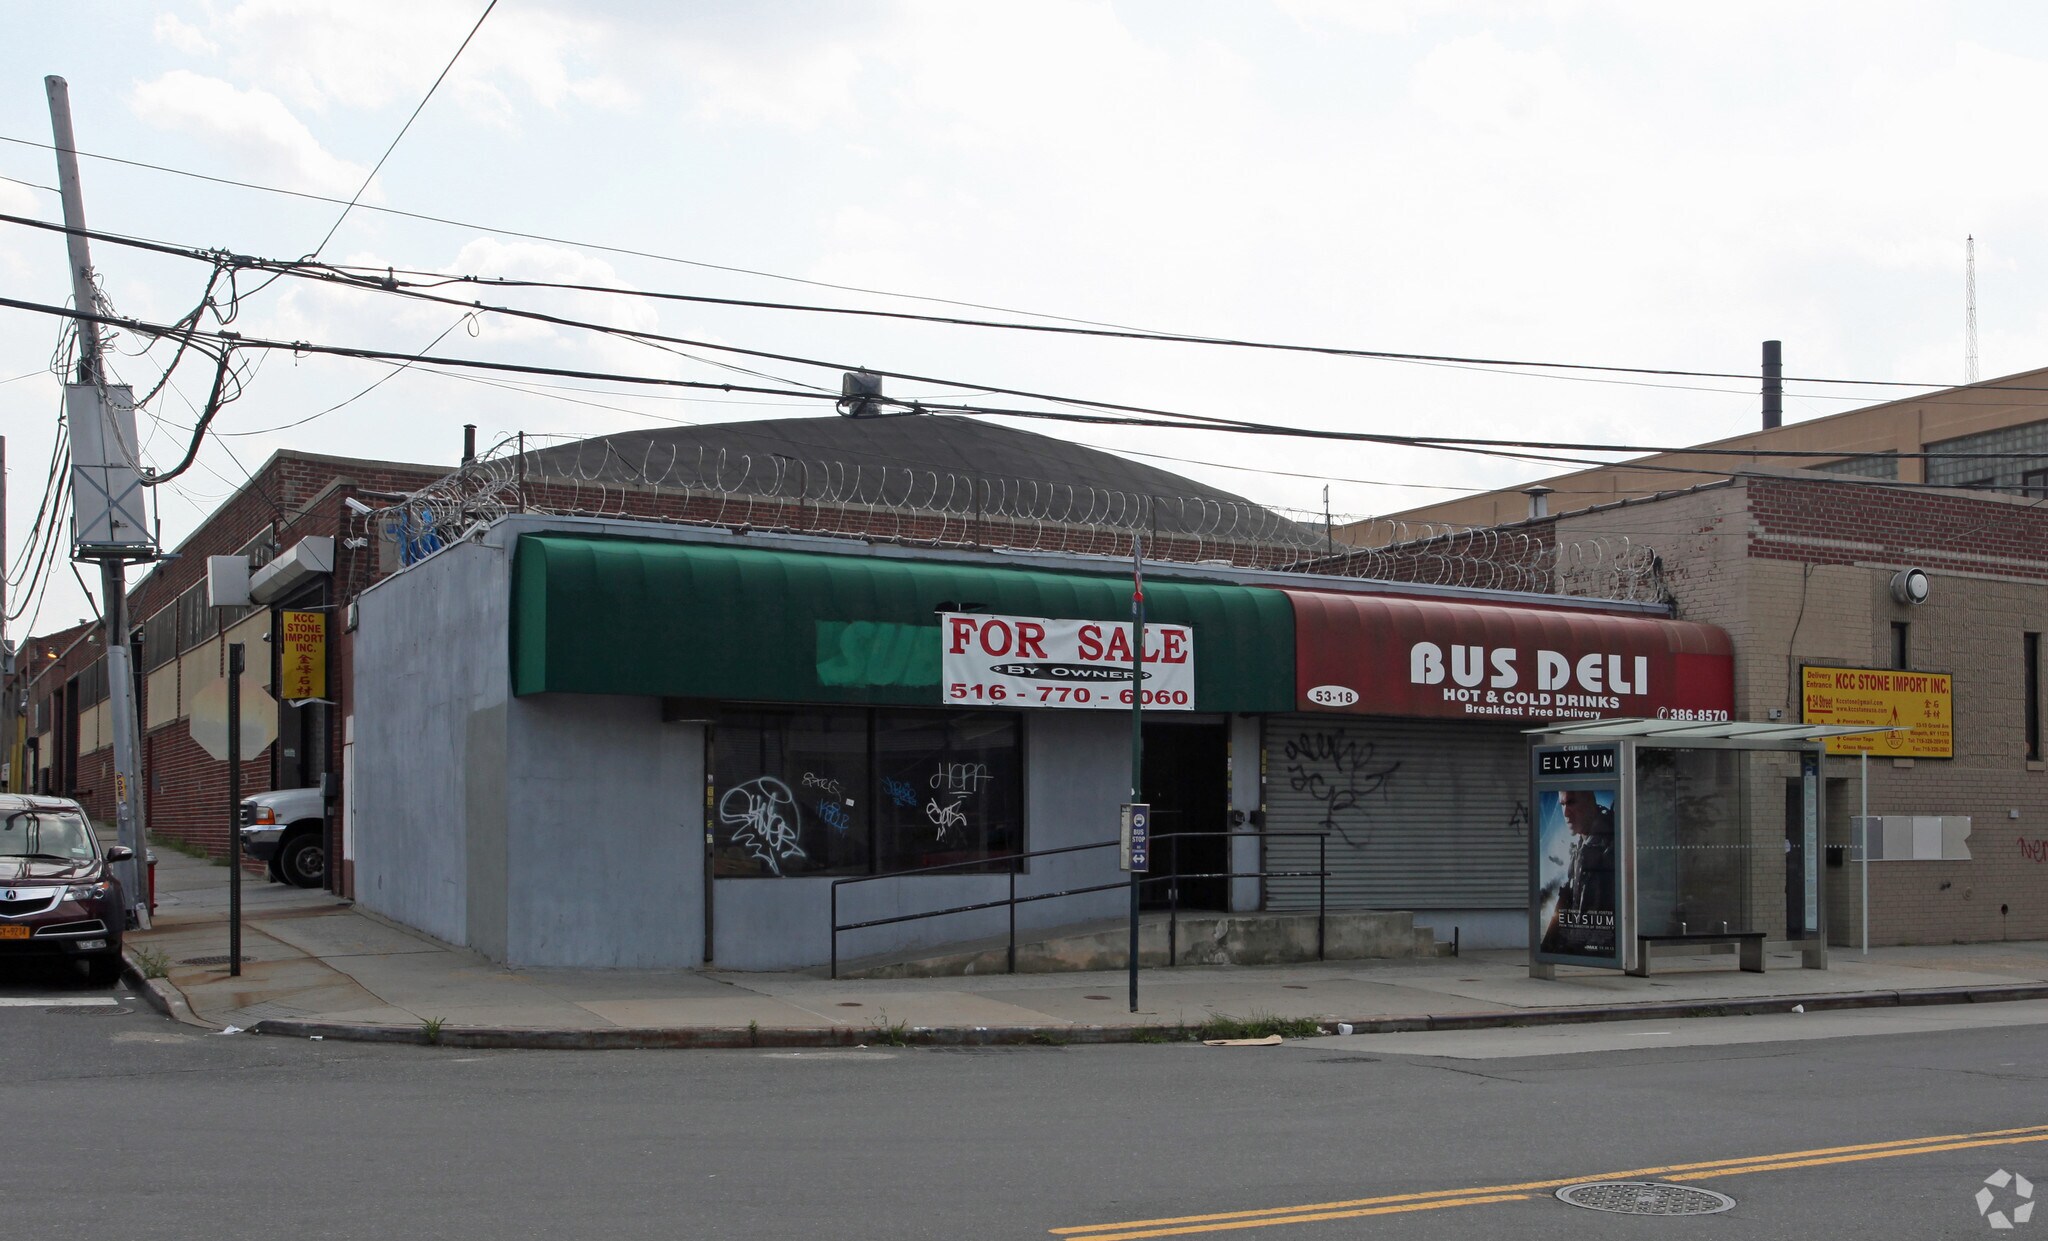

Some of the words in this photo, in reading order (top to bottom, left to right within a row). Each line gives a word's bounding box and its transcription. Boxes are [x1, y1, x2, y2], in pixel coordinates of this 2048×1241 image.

[294, 614, 315, 623] KCC
[287, 623, 321, 633] STONE
[285, 633, 324, 643] IMPORT
[949, 617, 1048, 659] FOR
[1077, 624, 1189, 664] SALE
[296, 644, 317, 653] INC.
[1410, 641, 1519, 689] BUS
[1537, 649, 1648, 695] DELI
[1807, 671, 1832, 680] Delivery
[1806, 681, 1832, 689] Entrance
[1835, 673, 1855, 690] KCC
[1859, 674, 1889, 691] STONE
[1893, 676, 1927, 693] IMPORT
[1931, 678, 1949, 694] INC.
[950, 683, 1007, 700] 516
[1037, 687, 1091, 703] 770
[1119, 688, 1188, 705] 6060
[1315, 690, 1353, 704] 53-18
[1443, 688, 1481, 703] HOT
[1486, 691, 1498, 703] &
[1503, 692, 1549, 706] COLD
[1552, 693, 1620, 709] DRINKS
[1820, 695, 1833, 708] Street
[1465, 703, 1523, 716] Breakfast
[1529, 706, 1553, 717] Free
[1555, 708, 1601, 722] Delivery
[1670, 708, 1728, 722] 386-8570
[1543, 754, 1613, 770] ELYSIUM
[1133, 828, 1145, 836] BUS
[1558, 913, 1614, 926] ELYSIUM
